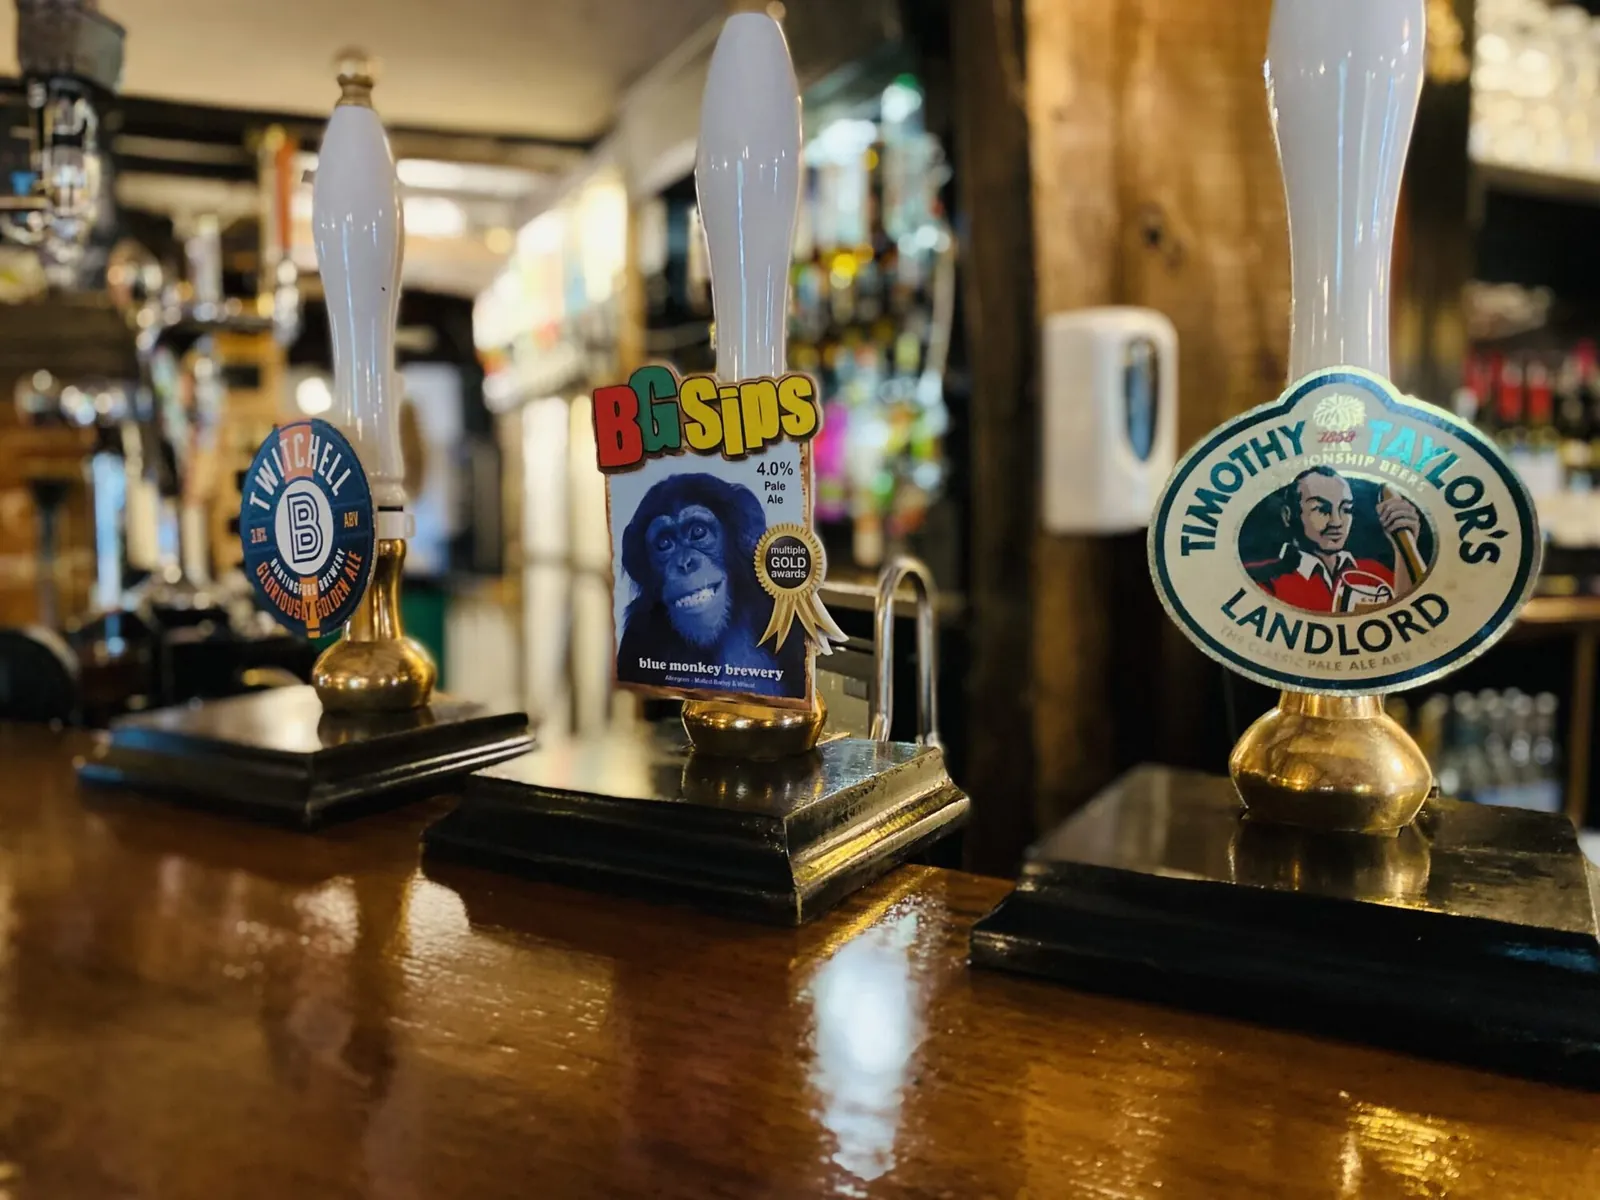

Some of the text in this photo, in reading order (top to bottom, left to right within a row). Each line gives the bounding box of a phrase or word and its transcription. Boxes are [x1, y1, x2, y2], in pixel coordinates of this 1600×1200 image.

[249, 432, 352, 512] TWITCHELL
[756, 461, 794, 477] 4.0%
[1378, 459, 1427, 493] BEERS
[764, 480, 786, 492] Pale
[1180, 418, 1511, 566] TIMOTHY TAYLOR'S
[766, 494, 784, 505] Ale
[286, 491, 324, 564] B
[343, 511, 359, 529] ABV
[770, 545, 807, 557] multiple
[771, 556, 807, 569] GOLD
[269, 547, 347, 597] BUNTINGFORD BREWERY
[771, 568, 807, 579] awards
[255, 549, 363, 621] GLORIOUSLY GOLDEN ALE
[1219, 586, 1450, 656] LANDLORD
[638, 657, 785, 681] blue monkey brewery
[1307, 659, 1342, 672] PALE
[1349, 658, 1378, 672] ALE
[1381, 649, 1412, 666] ABV
